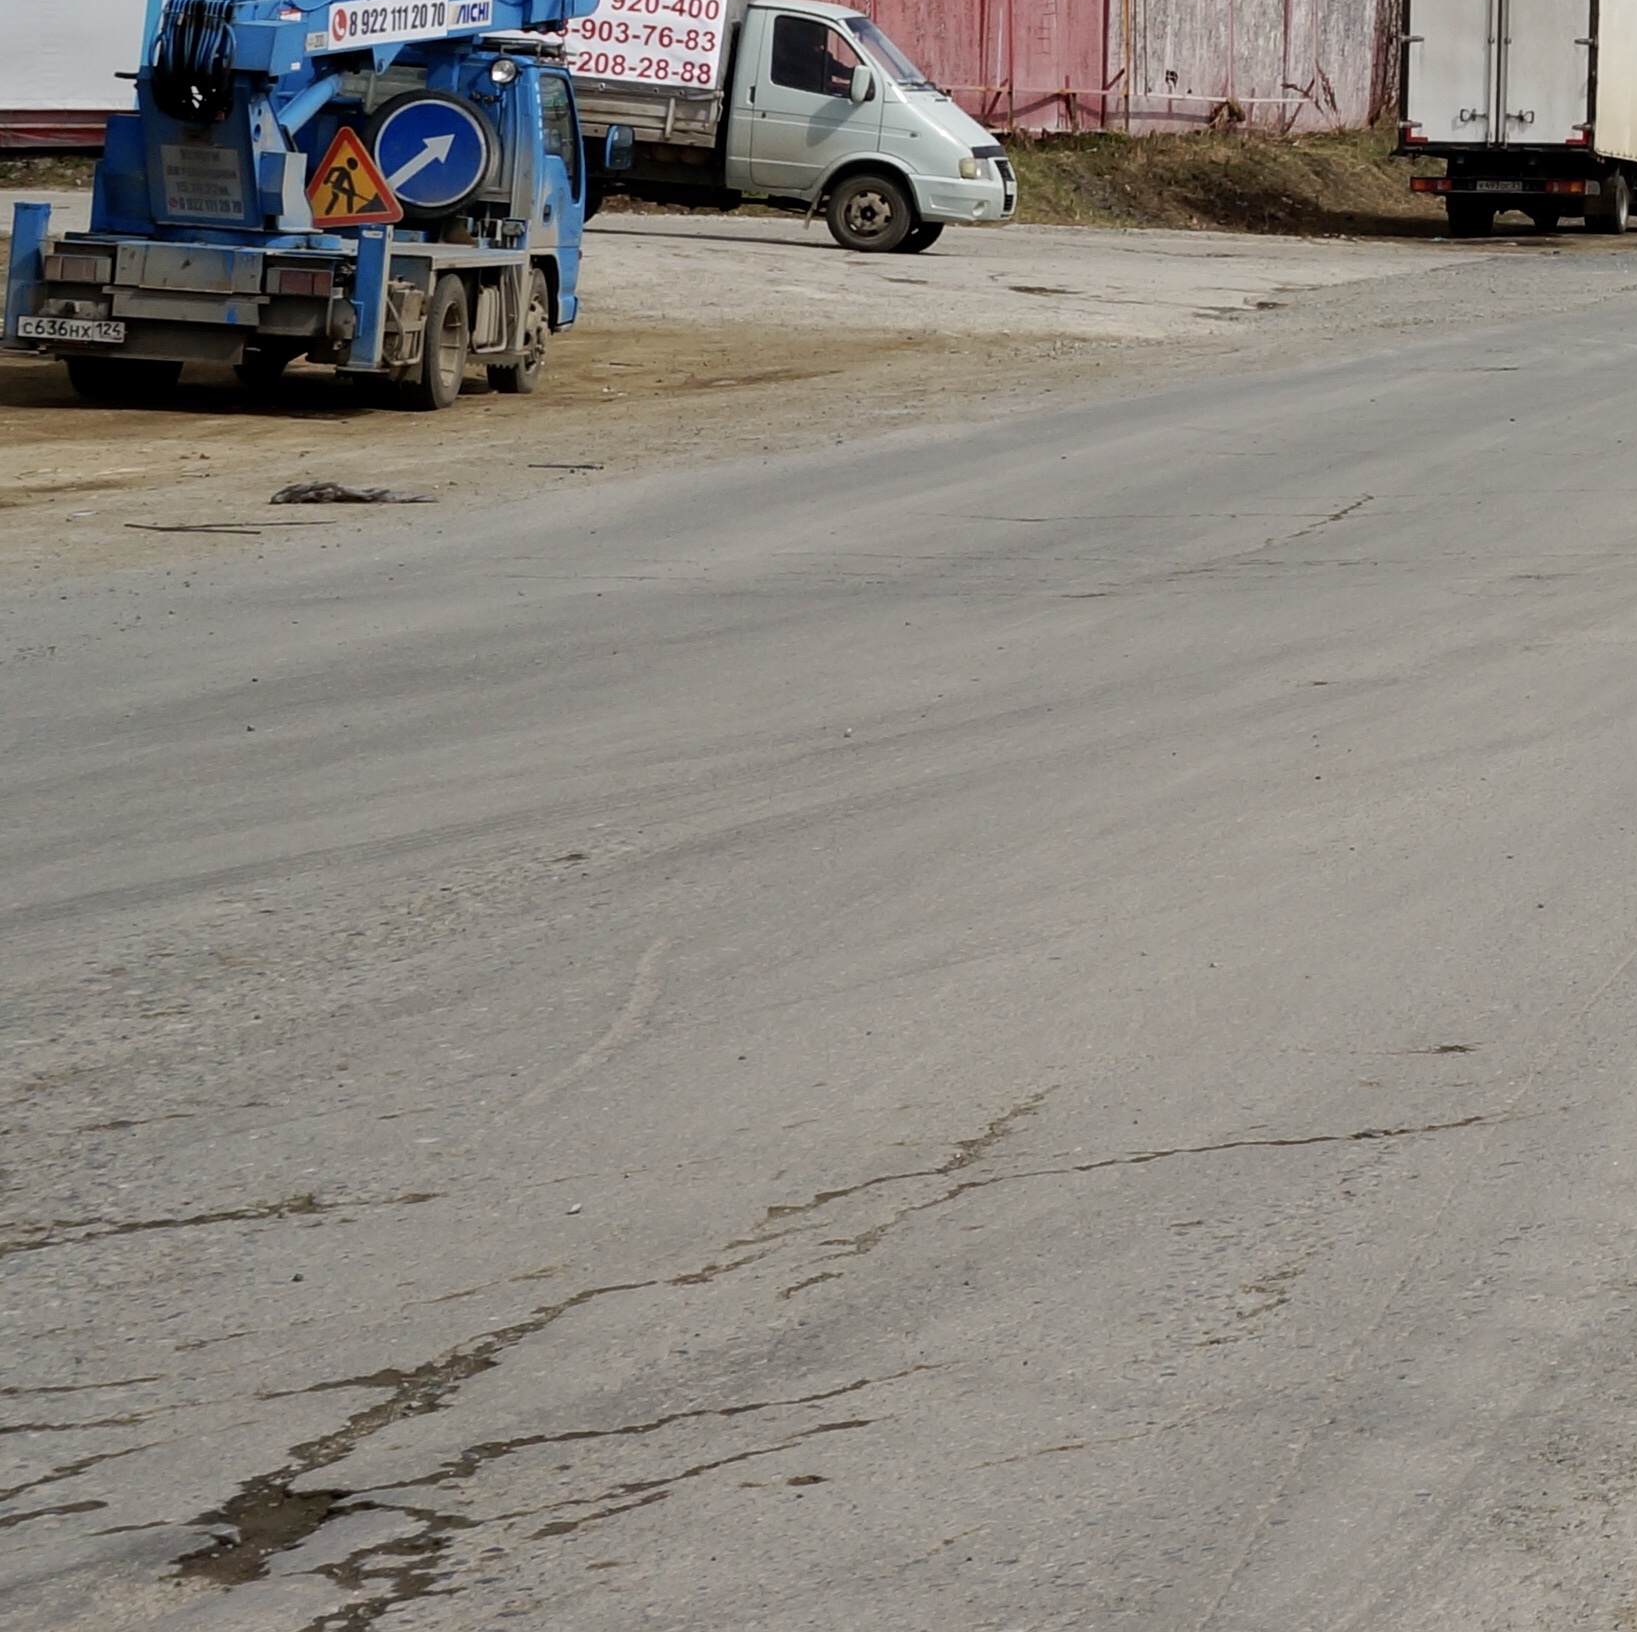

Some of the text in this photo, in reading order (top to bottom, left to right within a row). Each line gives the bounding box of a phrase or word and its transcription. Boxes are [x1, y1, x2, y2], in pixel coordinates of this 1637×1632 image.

[349, 2, 446, 36] 8 922 111 20 70
[23, 319, 122, 338] С636НХ 124
